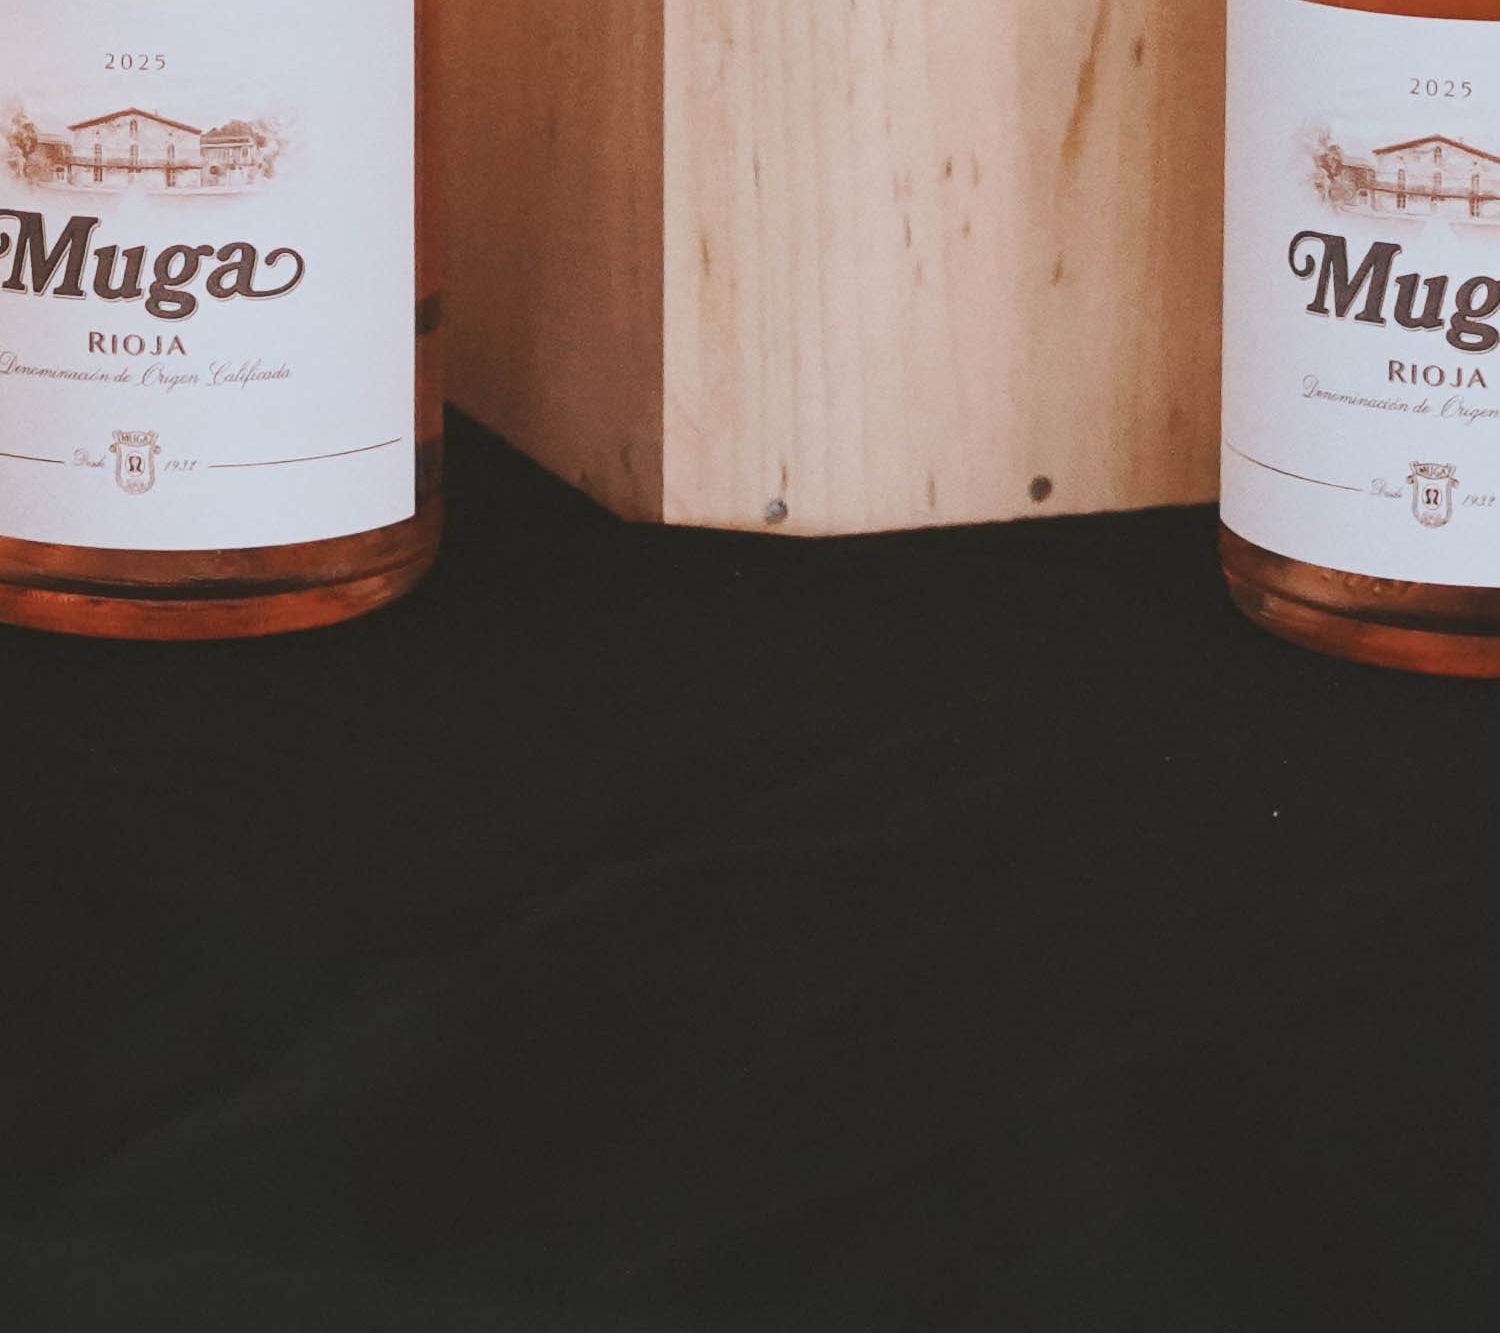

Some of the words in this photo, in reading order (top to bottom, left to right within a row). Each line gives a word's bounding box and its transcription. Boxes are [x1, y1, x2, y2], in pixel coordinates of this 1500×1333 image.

[103, 52, 168, 72] 2025
[1408, 77, 1475, 99] 2025
[87, 330, 188, 357] RIOJA
[113, 367, 131, 384] de
[205, 357, 294, 390] Calificada
[1388, 359, 1489, 389] RIOJA
[1413, 398, 1431, 415] de
[1435, 393, 1500, 427] Origen
